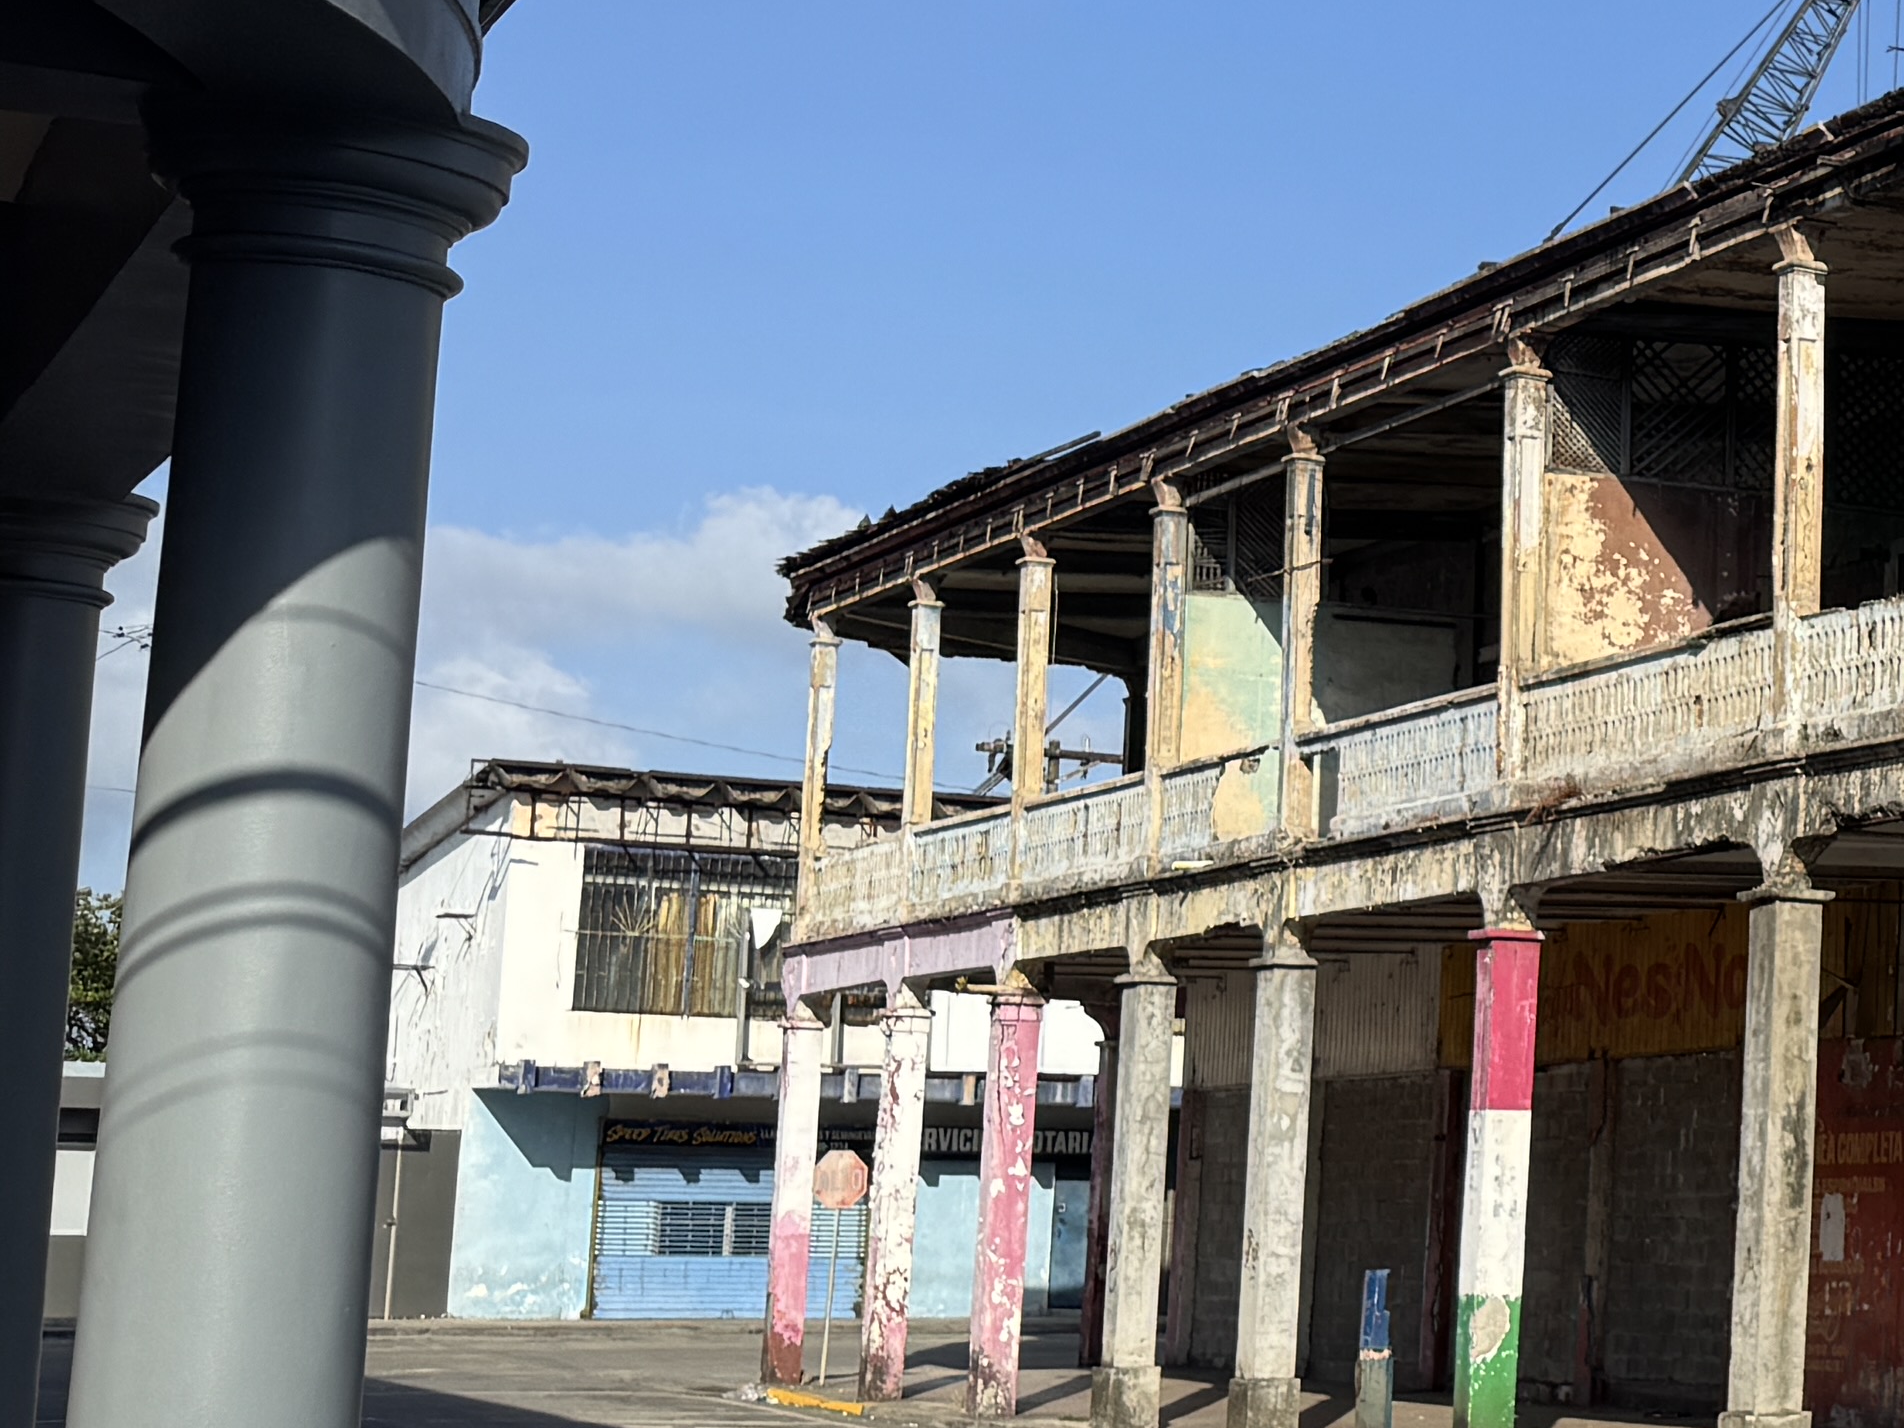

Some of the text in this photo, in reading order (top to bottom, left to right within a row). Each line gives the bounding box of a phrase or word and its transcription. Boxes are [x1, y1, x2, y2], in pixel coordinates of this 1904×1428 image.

[923, 1127, 1095, 1153] RVICI OTARI
[1838, 1131, 1904, 1164] COMPLETA
